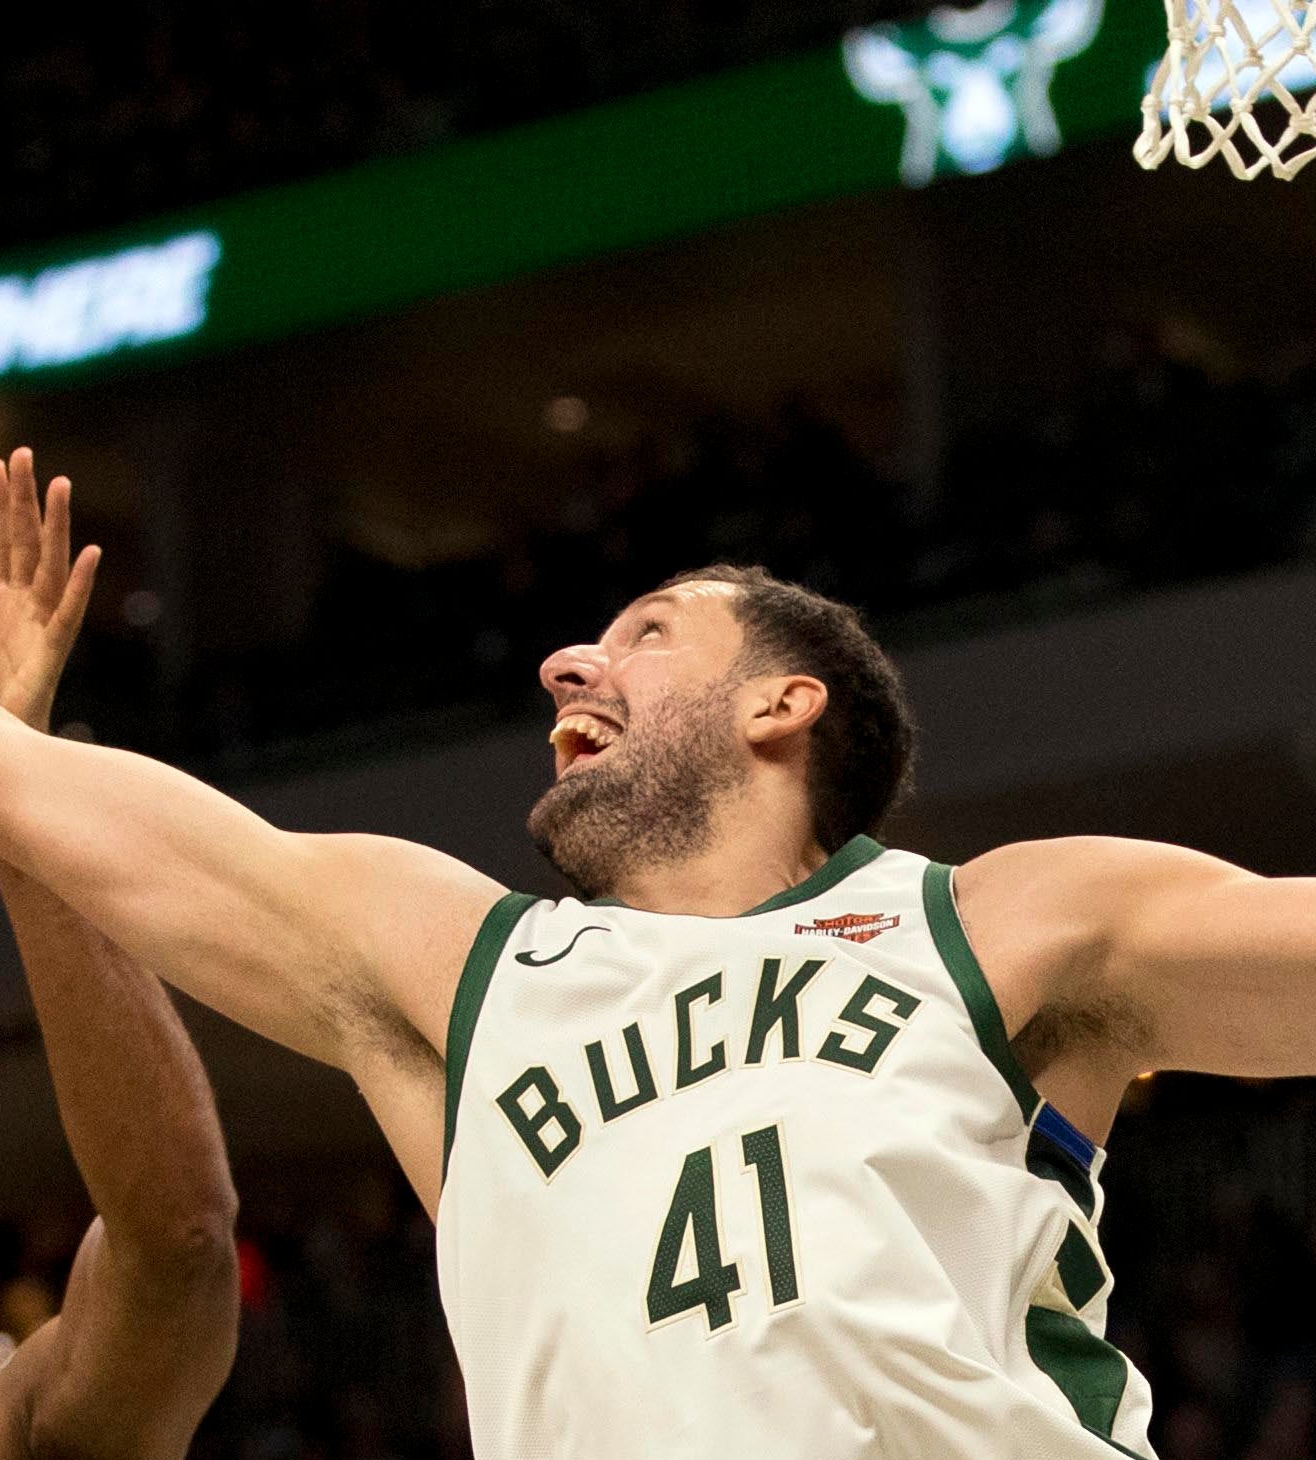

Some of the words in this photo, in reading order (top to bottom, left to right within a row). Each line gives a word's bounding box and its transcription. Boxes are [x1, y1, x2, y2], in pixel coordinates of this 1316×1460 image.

[801, 918, 894, 937] HARLEY-DAVIDSON
[494, 956, 923, 1185] BUCKS
[644, 1117, 806, 1338] 41
